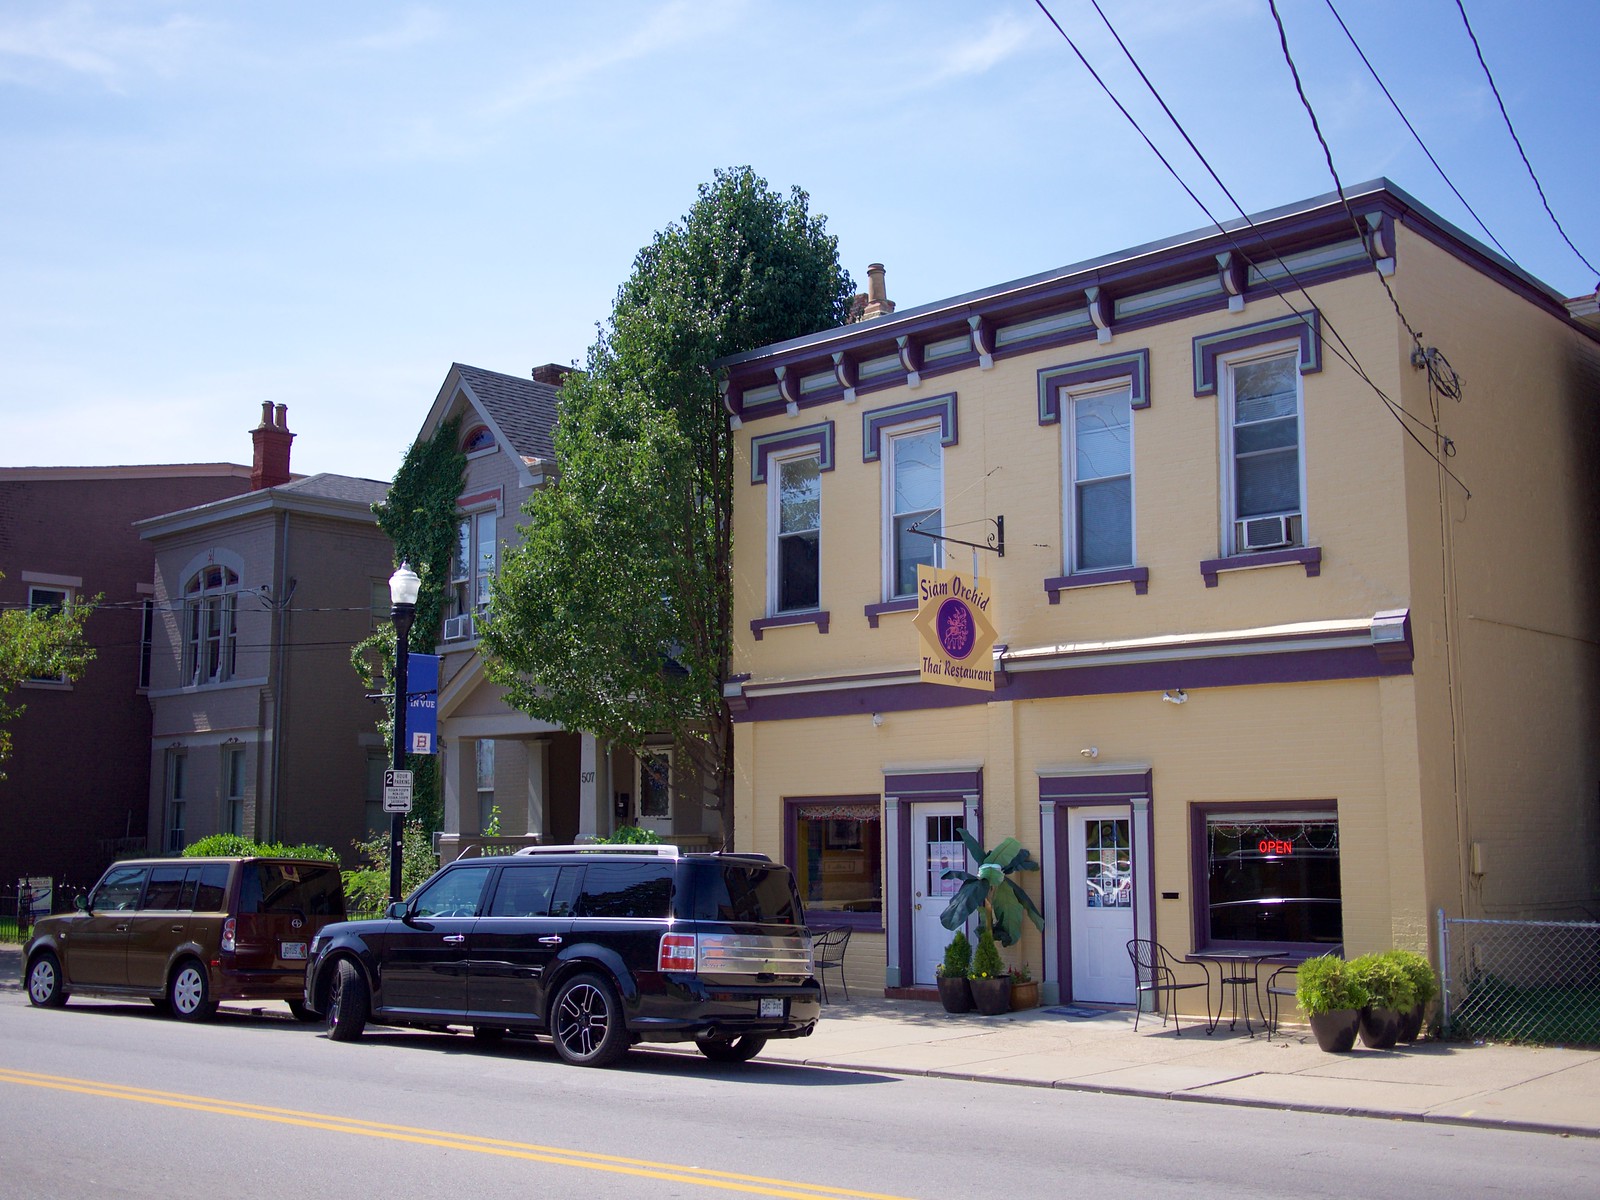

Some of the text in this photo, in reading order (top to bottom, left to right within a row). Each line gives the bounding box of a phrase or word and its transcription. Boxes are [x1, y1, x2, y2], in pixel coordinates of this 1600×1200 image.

[920, 576, 990, 612] Siam Orchid
[922, 656, 993, 683] Thai Restaurant
[421, 700, 436, 709] VUE
[386, 773, 393, 784] 2
[581, 771, 595, 784] 507
[1258, 839, 1293, 855] OPEN
